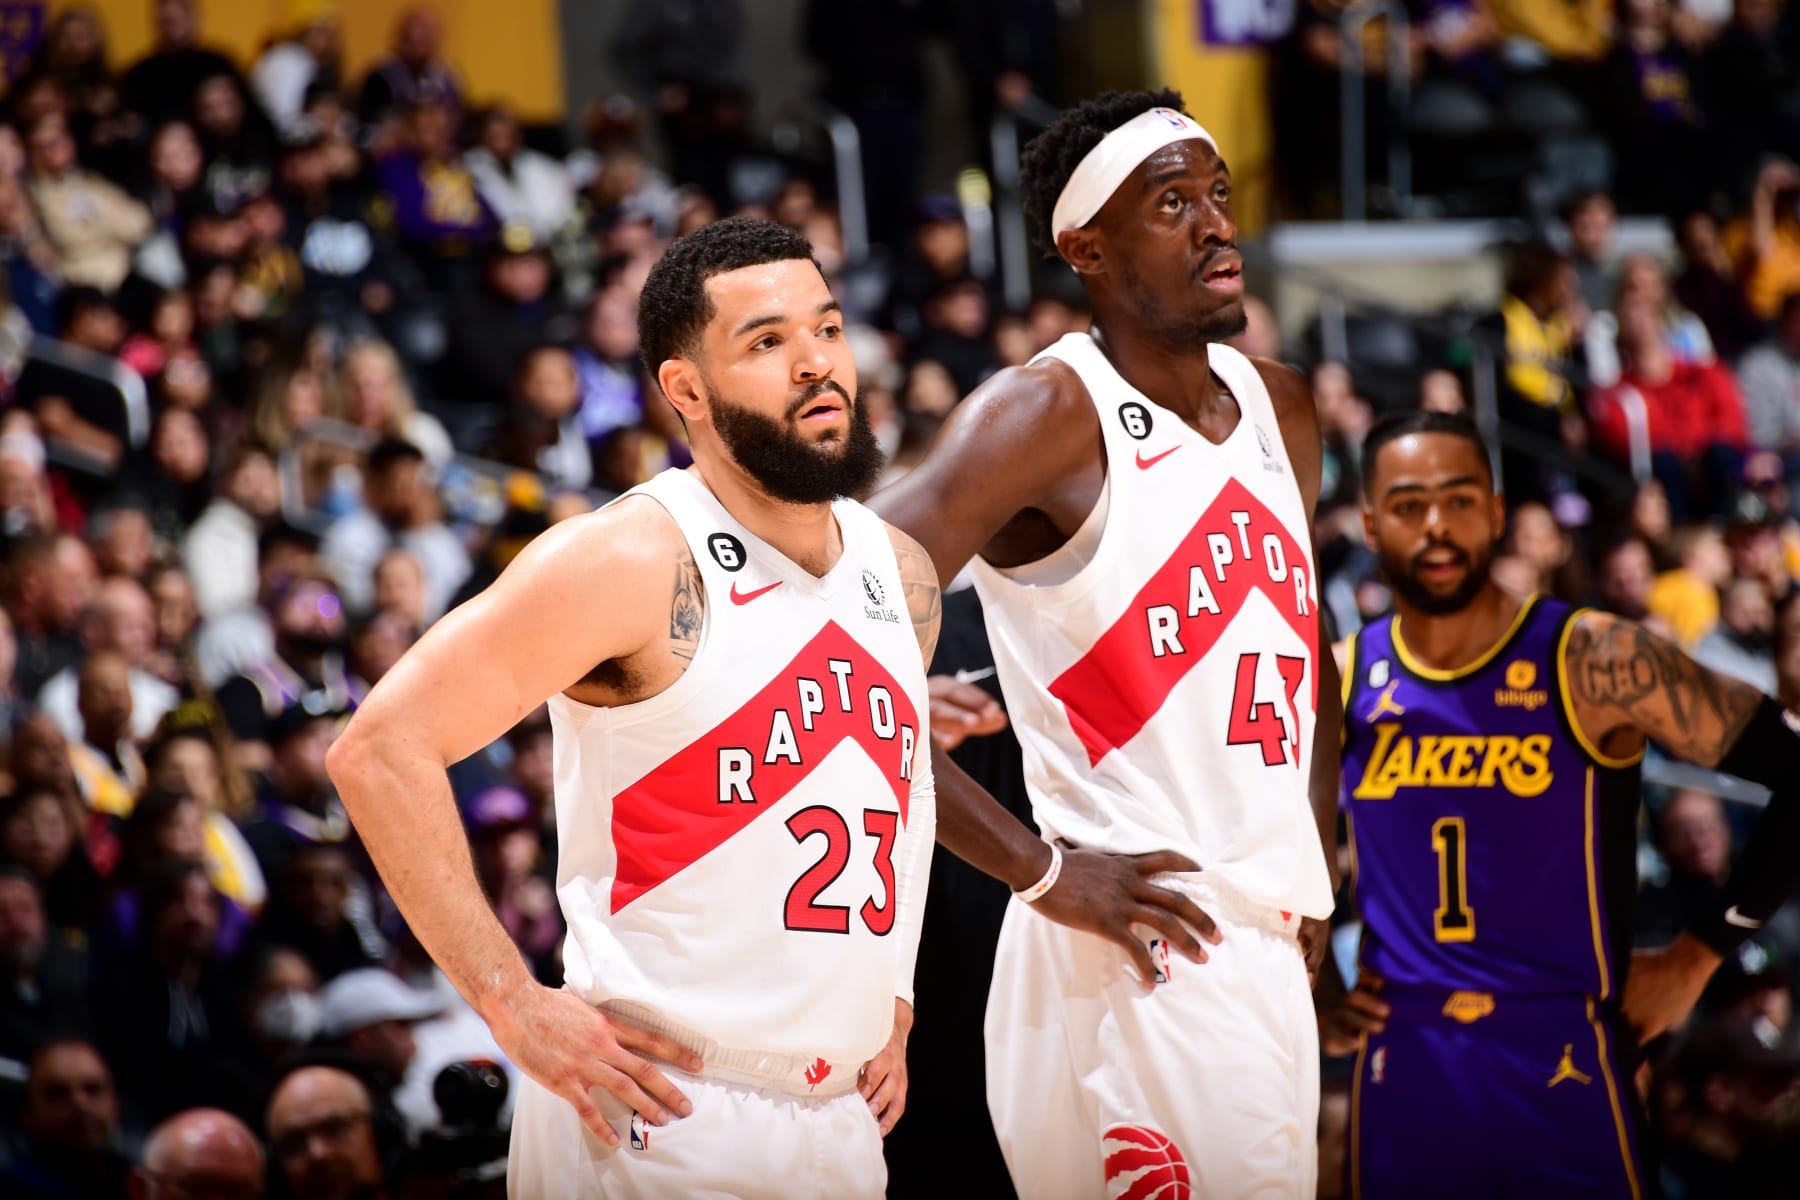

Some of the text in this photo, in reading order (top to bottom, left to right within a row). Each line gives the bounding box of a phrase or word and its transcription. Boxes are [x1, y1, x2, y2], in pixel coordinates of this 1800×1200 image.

[1122, 406, 1147, 437] 6
[712, 538, 740, 567] 6
[863, 605, 900, 624] Sun Life
[1227, 652, 1306, 770] 43
[1352, 722, 1555, 799] LAKERS
[783, 805, 899, 937] 23
[1431, 816, 1476, 943] 1
